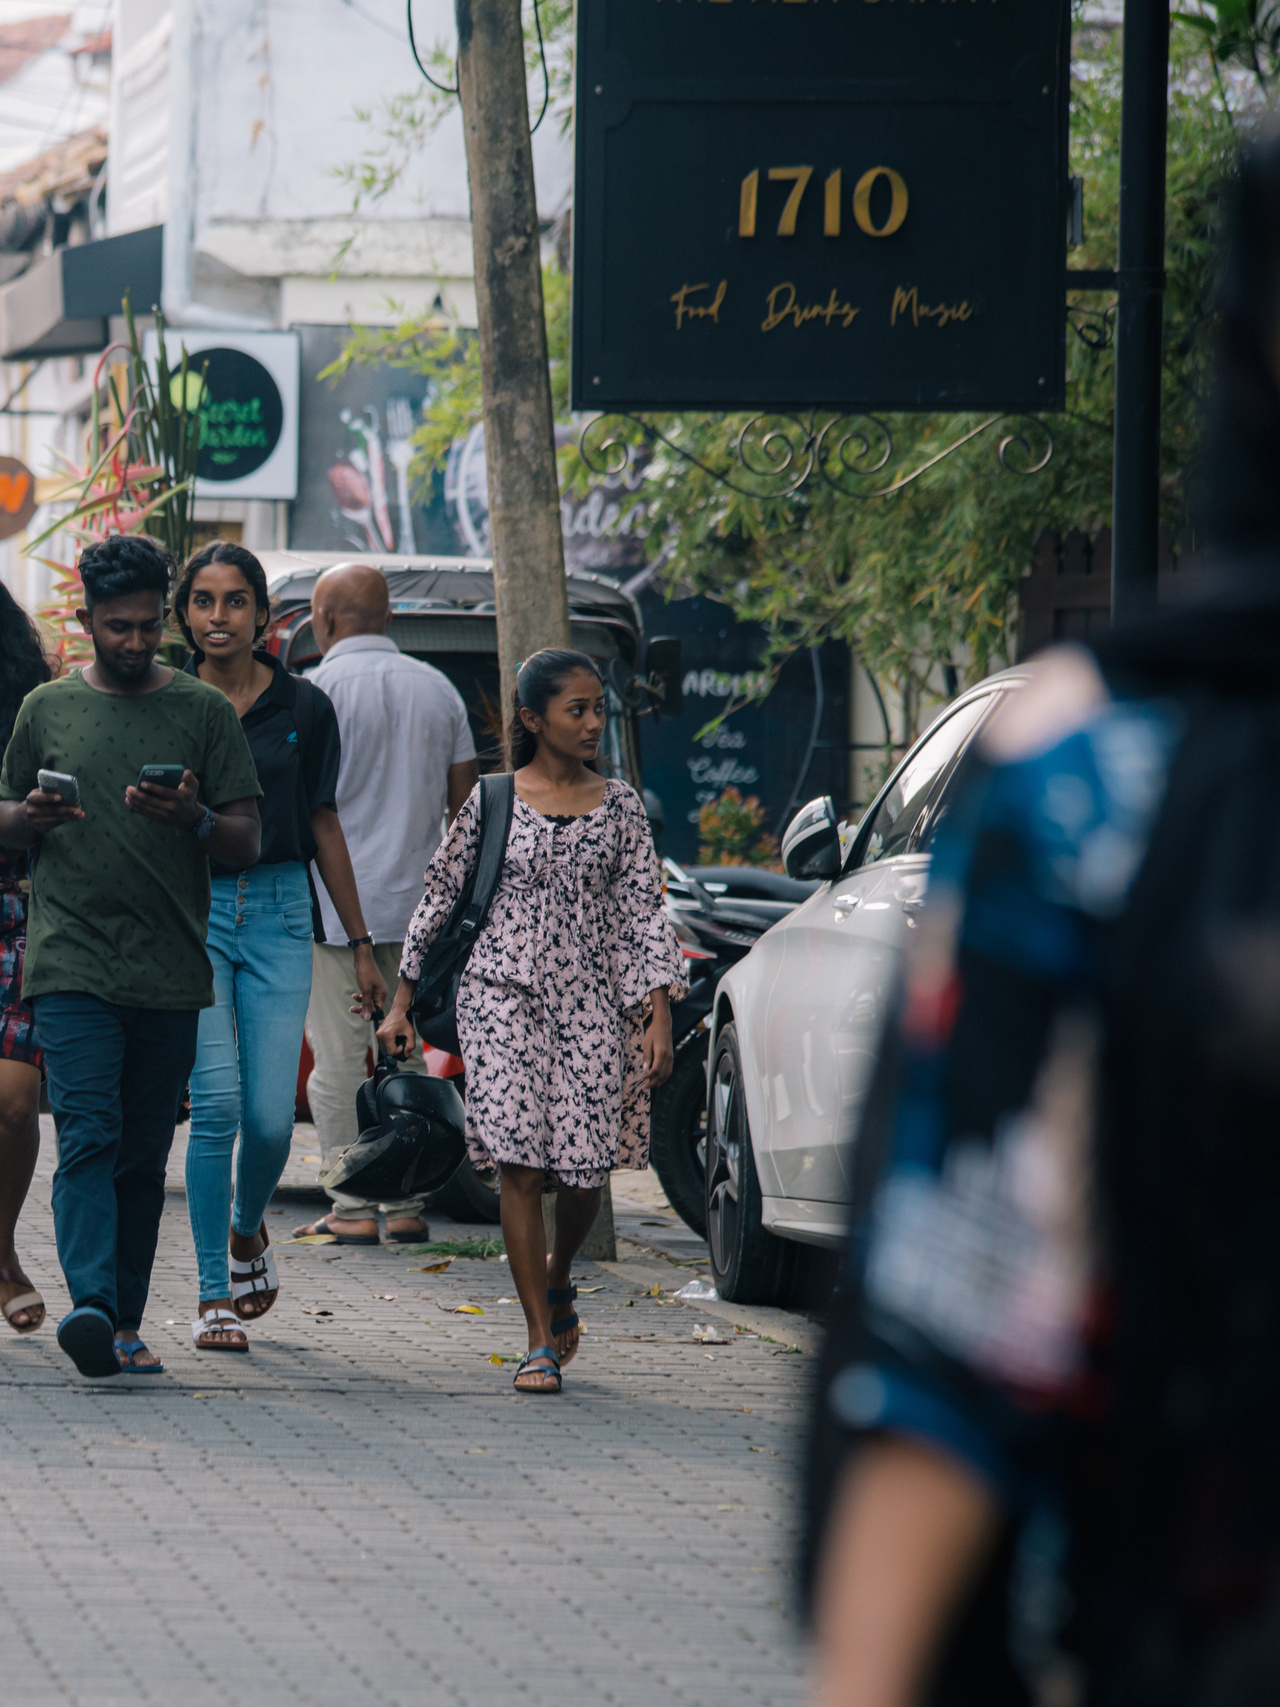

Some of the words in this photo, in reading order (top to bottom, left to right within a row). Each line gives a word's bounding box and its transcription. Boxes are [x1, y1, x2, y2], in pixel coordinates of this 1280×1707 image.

[739, 166, 909, 237] 1710
[761, 281, 860, 332] Drinks
[687, 755, 759, 789] Coffee
